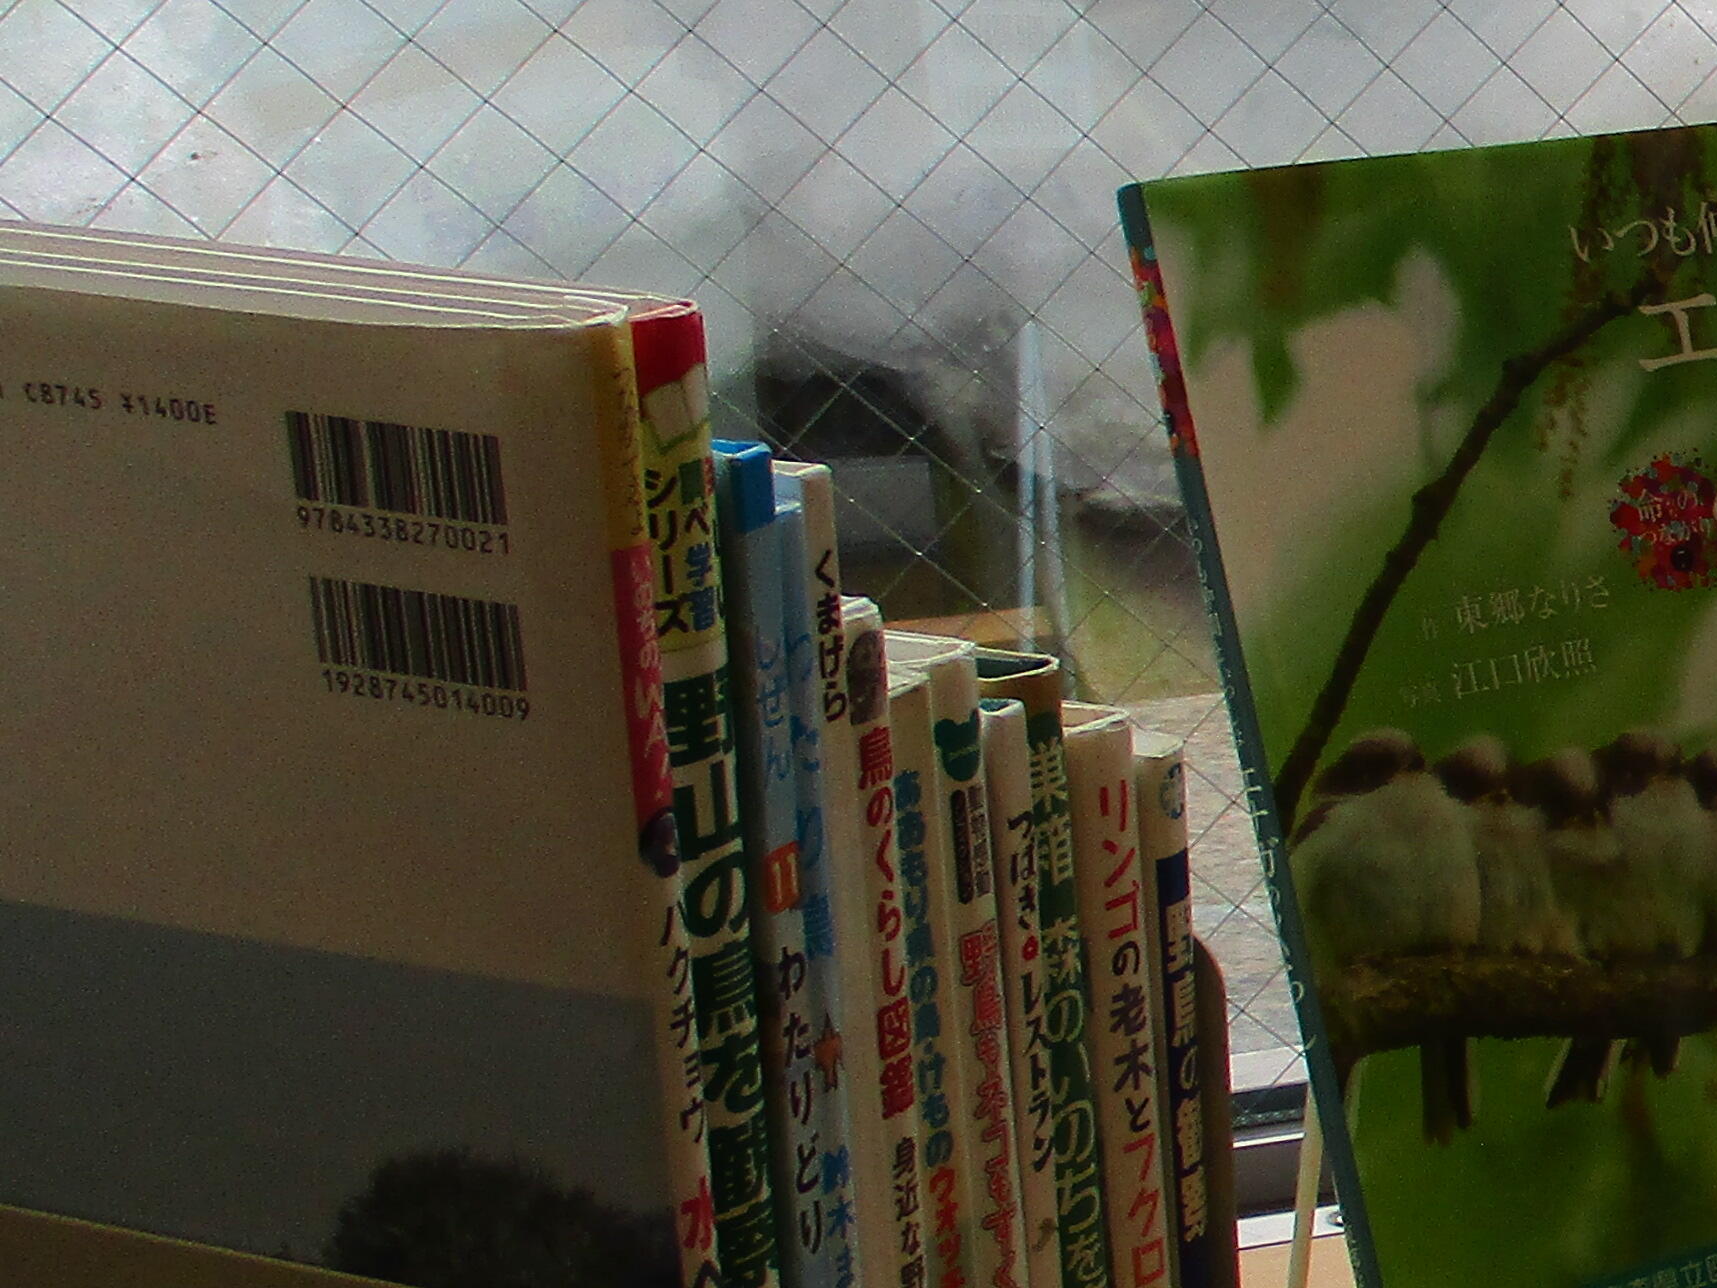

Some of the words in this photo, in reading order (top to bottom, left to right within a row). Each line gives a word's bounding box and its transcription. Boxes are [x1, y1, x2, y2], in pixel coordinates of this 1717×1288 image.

[296, 502, 511, 558] 9784338270021
[643, 468, 690, 638] シリーズ
[1456, 575, 1611, 635] 東郷なりさ
[320, 666, 532, 722] 1928745014009
[1452, 637, 1598, 700] 江口欣照
[859, 724, 916, 1122] 鳥のくらし図鑑
[659, 897, 707, 1144] ハクチョウ
[780, 944, 823, 1256] わたりどり
[1021, 970, 1055, 1174] レストラン
